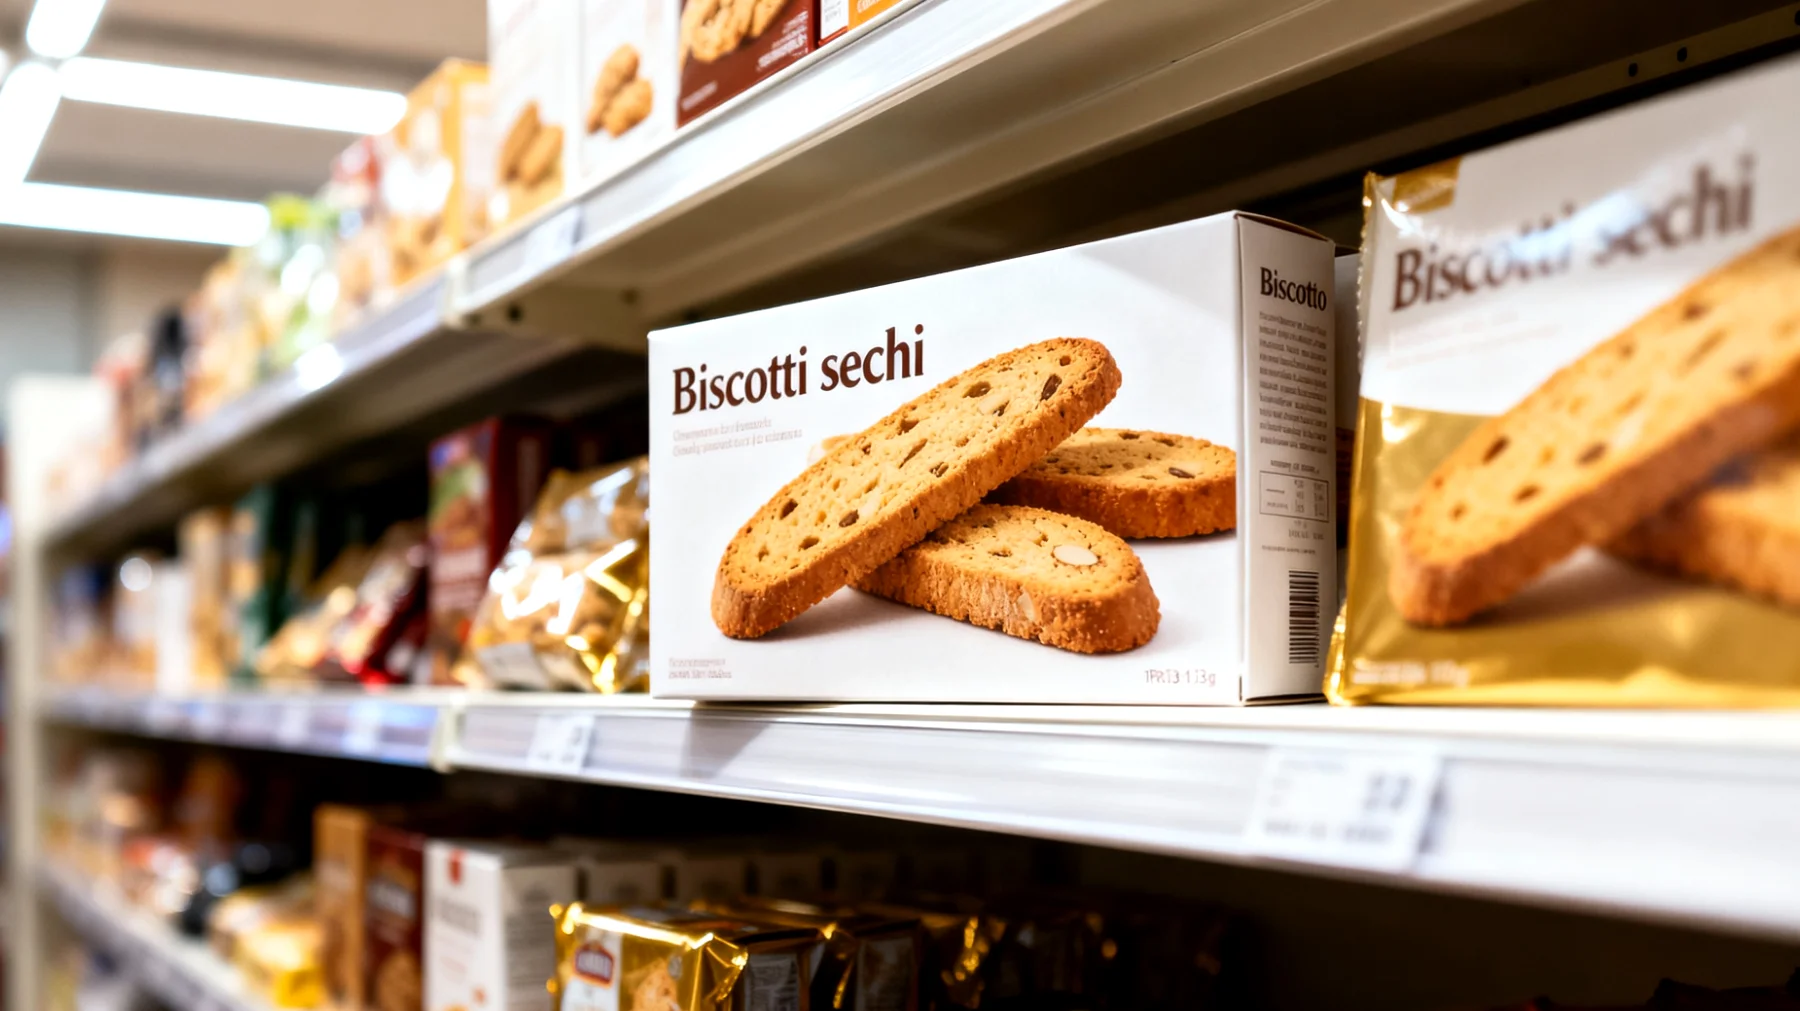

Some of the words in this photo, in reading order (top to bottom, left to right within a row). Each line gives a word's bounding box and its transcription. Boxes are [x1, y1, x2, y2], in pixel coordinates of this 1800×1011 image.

[1260, 266, 1327, 312] Biscotto
[672, 345, 807, 415] Biscotti
[820, 323, 924, 391] sechi
